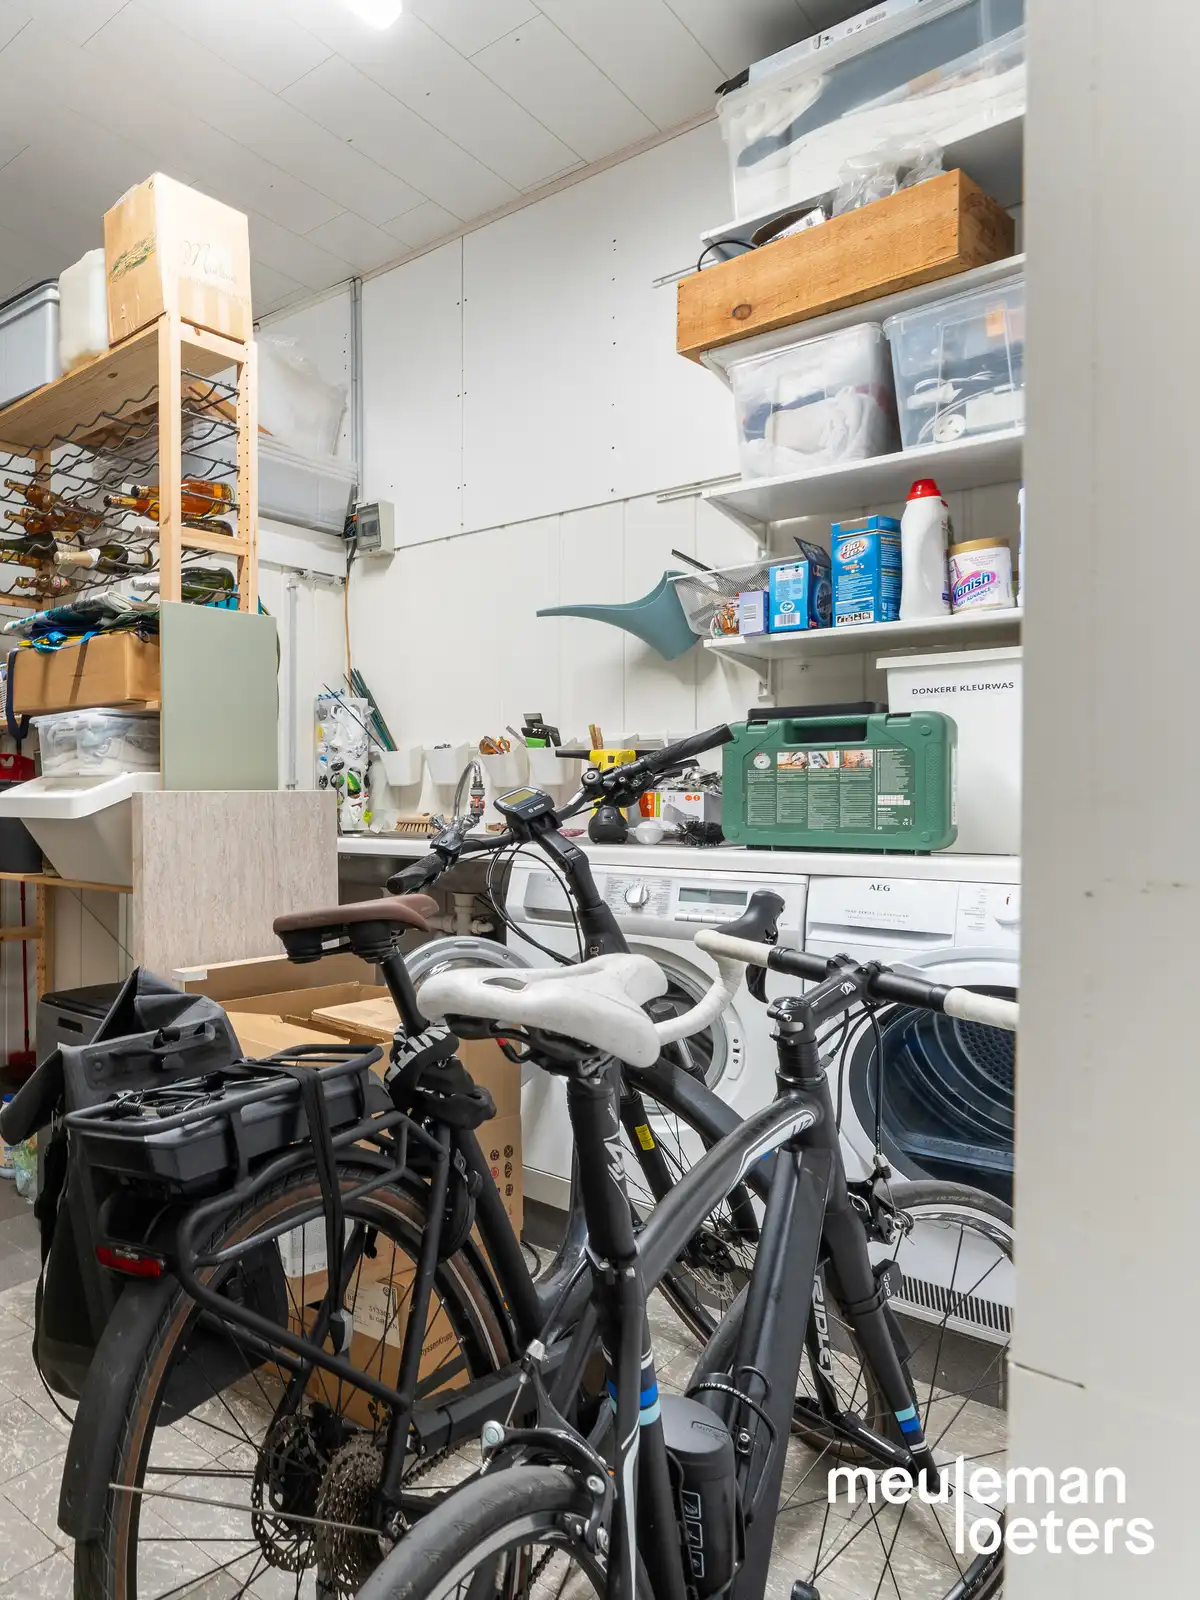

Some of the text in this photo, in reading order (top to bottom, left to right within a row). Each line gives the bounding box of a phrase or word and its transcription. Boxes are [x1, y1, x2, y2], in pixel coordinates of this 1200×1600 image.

[911, 681, 1015, 695] DONKERE KLEURWAS
[868, 884, 891, 892] AEG
[698, 1381, 753, 1404] BONTRAGER
